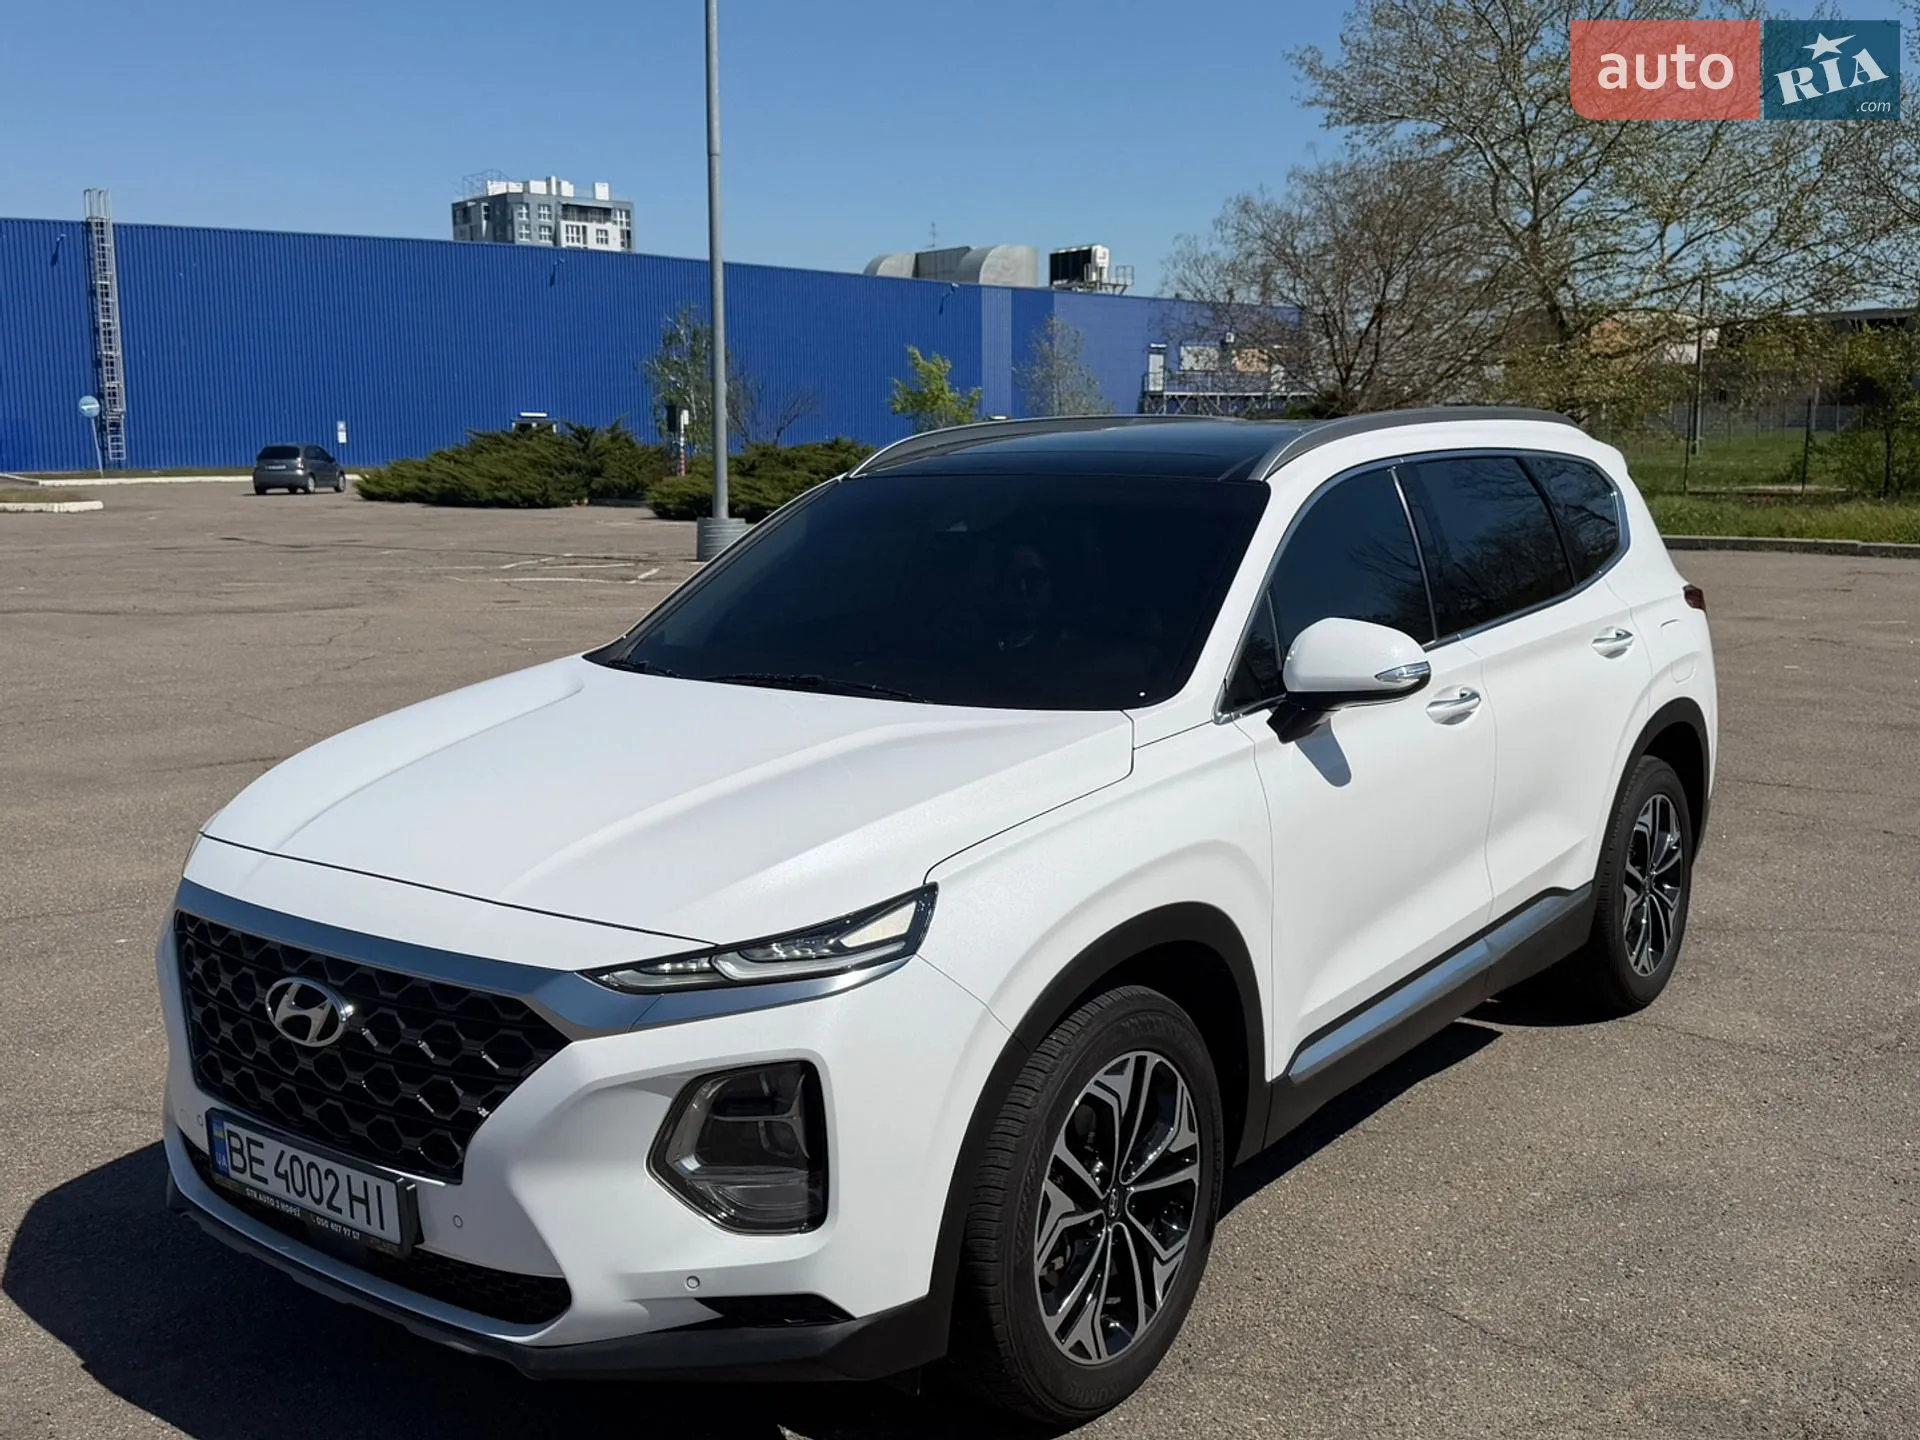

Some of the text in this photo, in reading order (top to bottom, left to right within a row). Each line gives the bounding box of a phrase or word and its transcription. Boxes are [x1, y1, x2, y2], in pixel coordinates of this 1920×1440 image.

[216, 1153, 228, 1170] UA
[226, 1129, 385, 1231] BE 4002 HI
